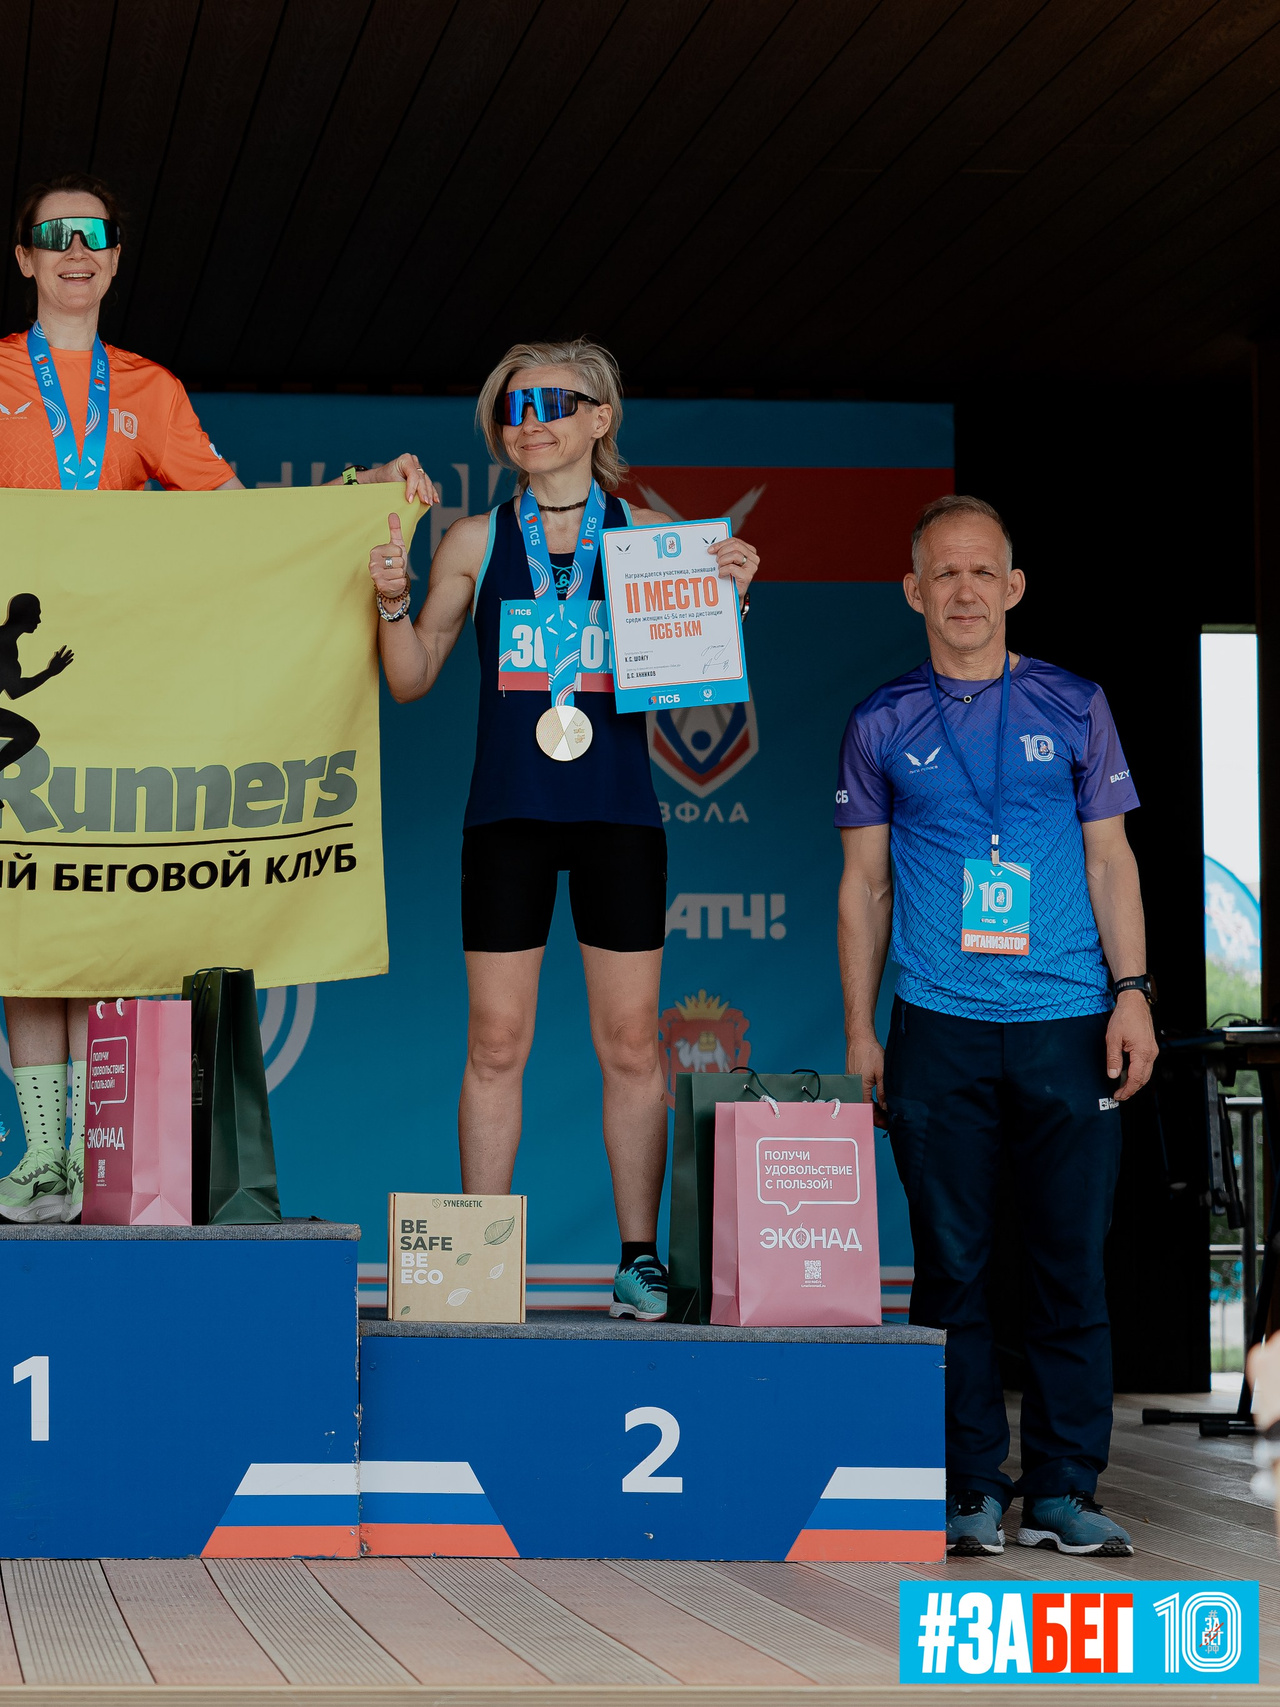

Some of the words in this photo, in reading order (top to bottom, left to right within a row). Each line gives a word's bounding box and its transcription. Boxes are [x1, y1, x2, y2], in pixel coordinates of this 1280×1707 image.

[39, 365, 54, 387] ПСБ
[94, 358, 106, 380] ПСБ
[110, 408, 138, 440] 10
[528, 525, 541, 546] ПСБ
[585, 516, 597, 537] ПСБ
[652, 532, 682, 559] 10
[643, 575, 719, 612] МЕСТО
[515, 608, 532, 616] ПСБ
[649, 622, 673, 640] ПСБ
[674, 621, 683, 638] 5
[683, 619, 702, 636] КМ
[658, 694, 681, 705] ПСБ
[1020, 734, 1056, 762] 10
[1110, 769, 1130, 783] EAZY
[836, 791, 849, 804] СБ
[53, 849, 251, 893] БЕГОВОЙ
[265, 843, 358, 885] КЛУБ
[978, 881, 1013, 913] 10
[665, 893, 787, 940] АТЧ!
[964, 933, 1027, 951] ОРГАНИЗАТОР
[92, 1051, 109, 1062] ПОЛУЧИ
[92, 1064, 125, 1076] УДОВОЛЬСТВИЕ
[94, 1077, 116, 1090] ПОЛЬЗОЙ!
[86, 1125, 125, 1150] ЭКОНАД
[764, 1150, 811, 1161] ПОЛУЧИ
[764, 1165, 853, 1176] УДОВОЛЬСТВИЕ
[765, 1179, 773, 1190] С
[776, 1177, 833, 1190] ПОЛЬЗОЙ!
[443, 1199, 483, 1208] SYNERGETIC
[401, 1219, 428, 1234] BE
[400, 1235, 453, 1251] SAFE
[759, 1226, 863, 1252] ЭКОНАД
[401, 1252, 428, 1267] BE
[401, 1269, 444, 1285] ECO
[13, 1355, 50, 1442] 1
[622, 1406, 683, 1493] 2
